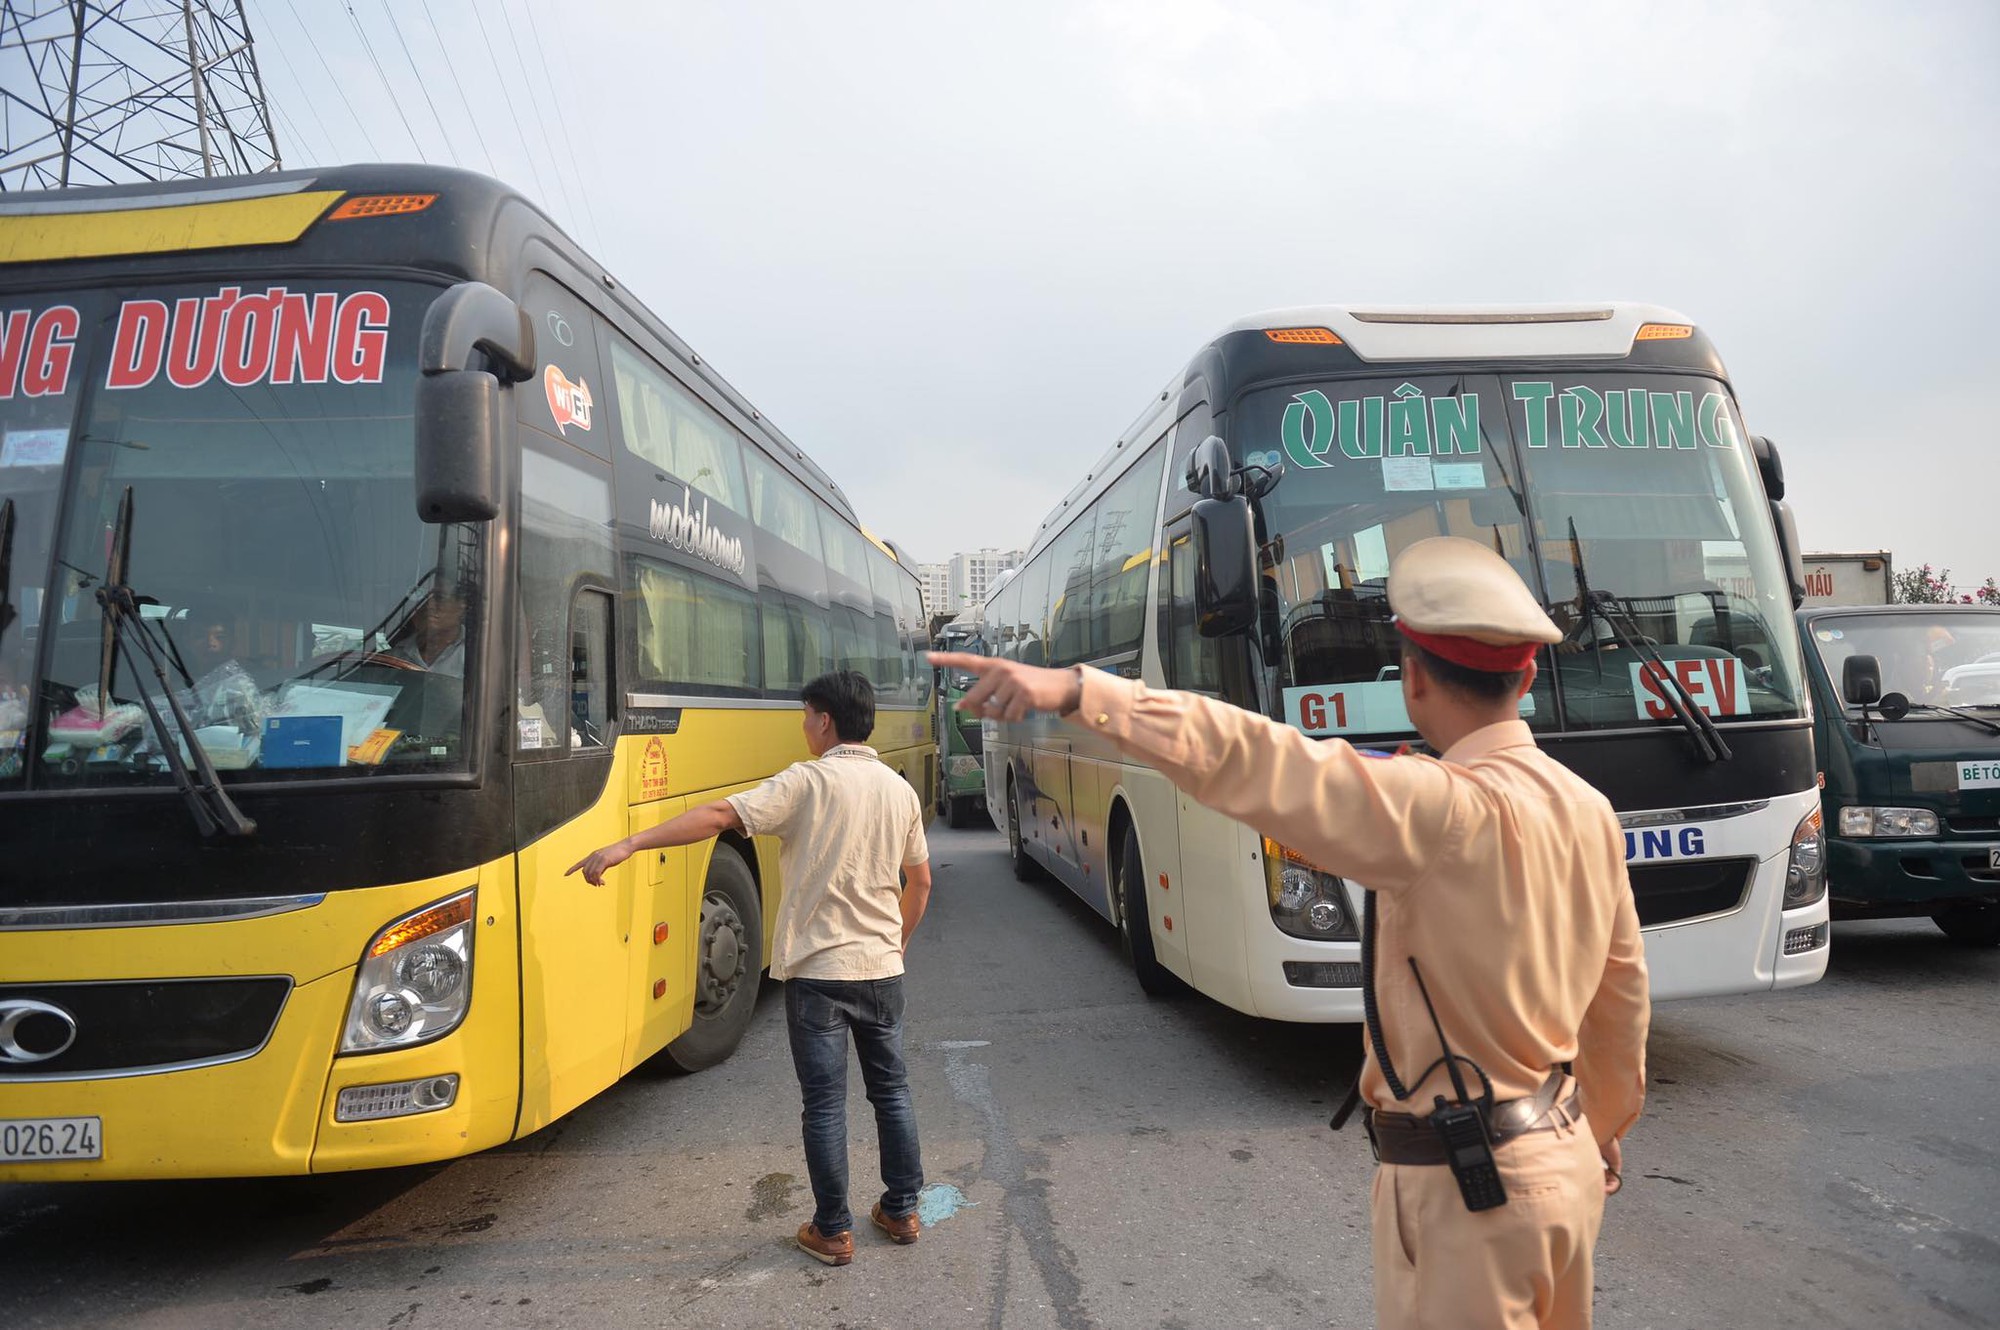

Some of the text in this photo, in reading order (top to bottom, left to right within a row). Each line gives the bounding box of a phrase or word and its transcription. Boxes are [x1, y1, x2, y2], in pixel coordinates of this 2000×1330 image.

[105, 286, 391, 390] DƯƠNG
[1281, 381, 1735, 469] QUÂN TRUNG
[1300, 692, 1347, 731] G1
[1639, 657, 1736, 720] SEV
[4, 1122, 95, 1156] 026.24
